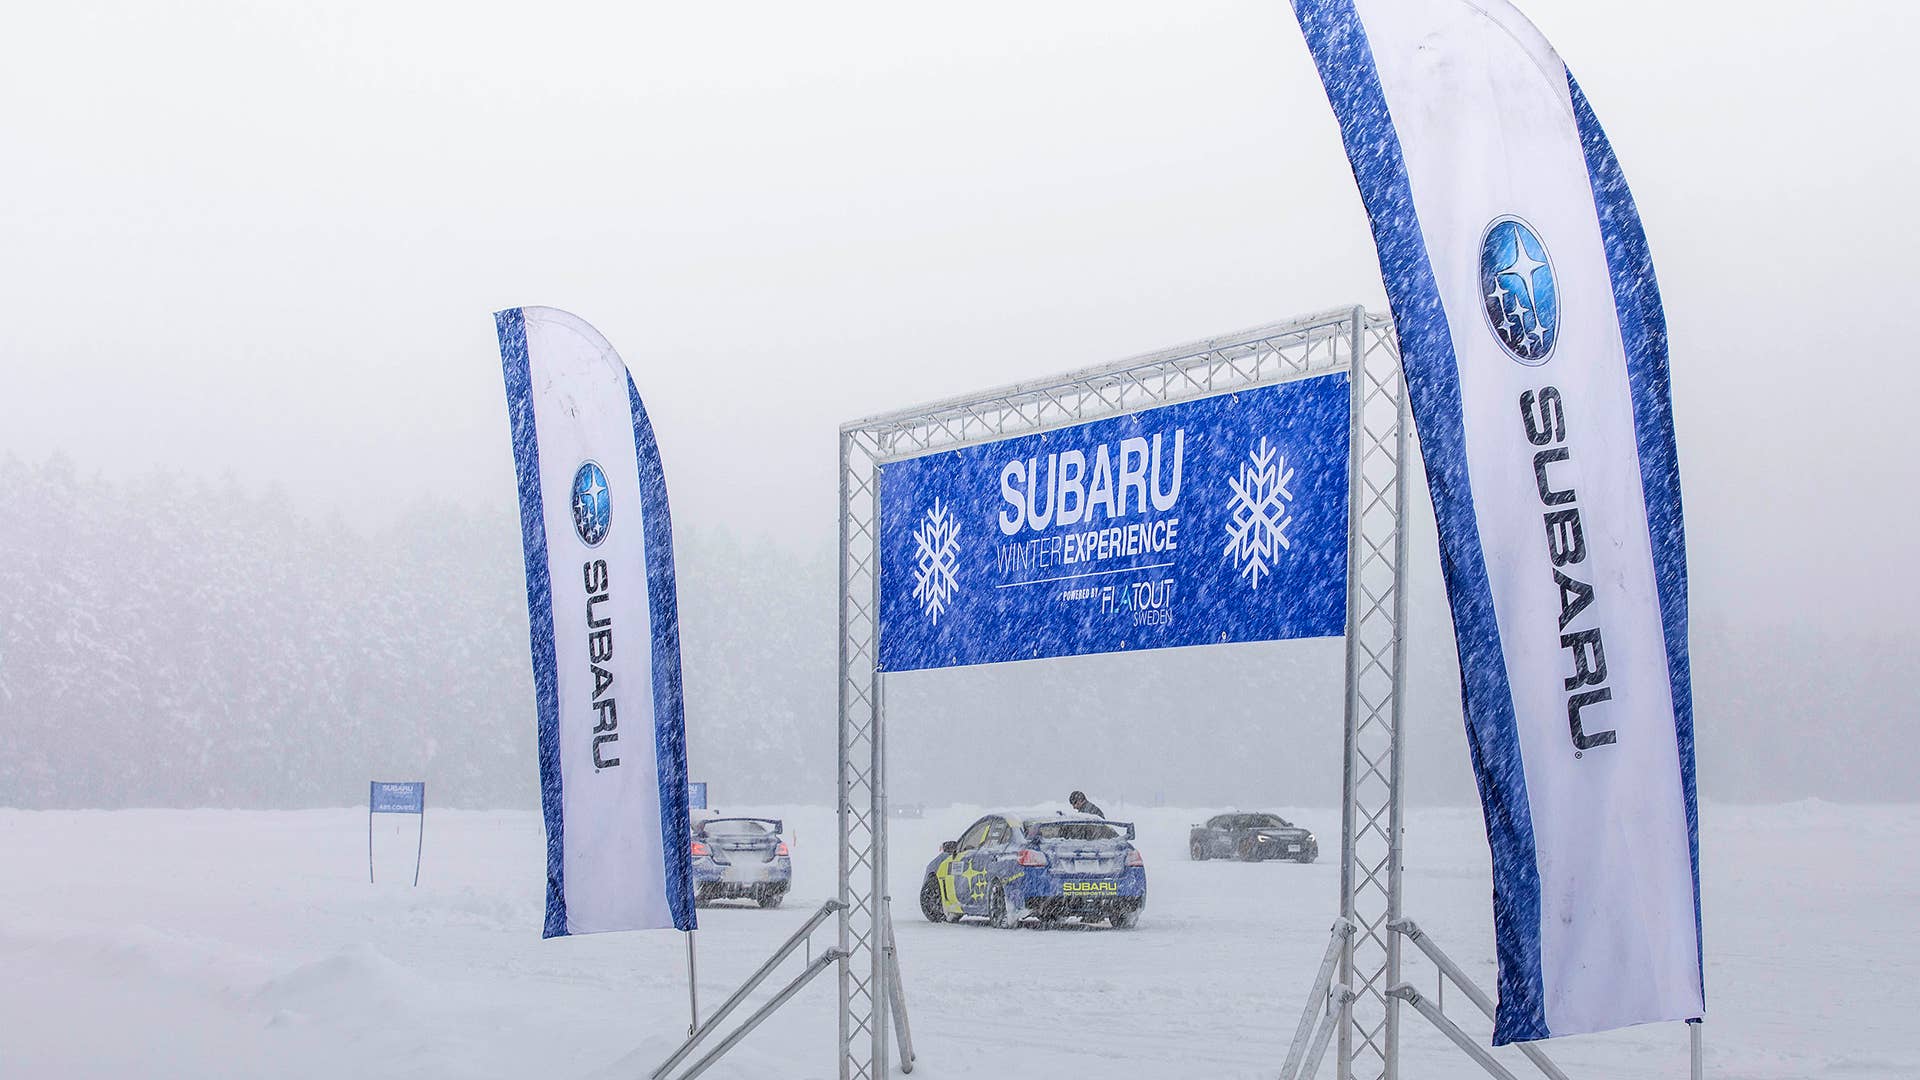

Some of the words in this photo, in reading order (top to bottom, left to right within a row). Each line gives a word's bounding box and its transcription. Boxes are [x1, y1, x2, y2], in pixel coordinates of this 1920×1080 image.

[999, 429, 1185, 536] SUBARU
[996, 535, 1061, 573] WINTER
[1063, 518, 1179, 565] EXPERIENCE
[1519, 385, 1617, 751] SUBARU
[1063, 588, 1090, 601] POWERED
[1091, 587, 1099, 599] BY
[1133, 608, 1173, 627] SWEDEN
[583, 559, 621, 770] SUBARU
[382, 784, 414, 792] SUBARU
[1063, 882, 1117, 891] SUBARU
